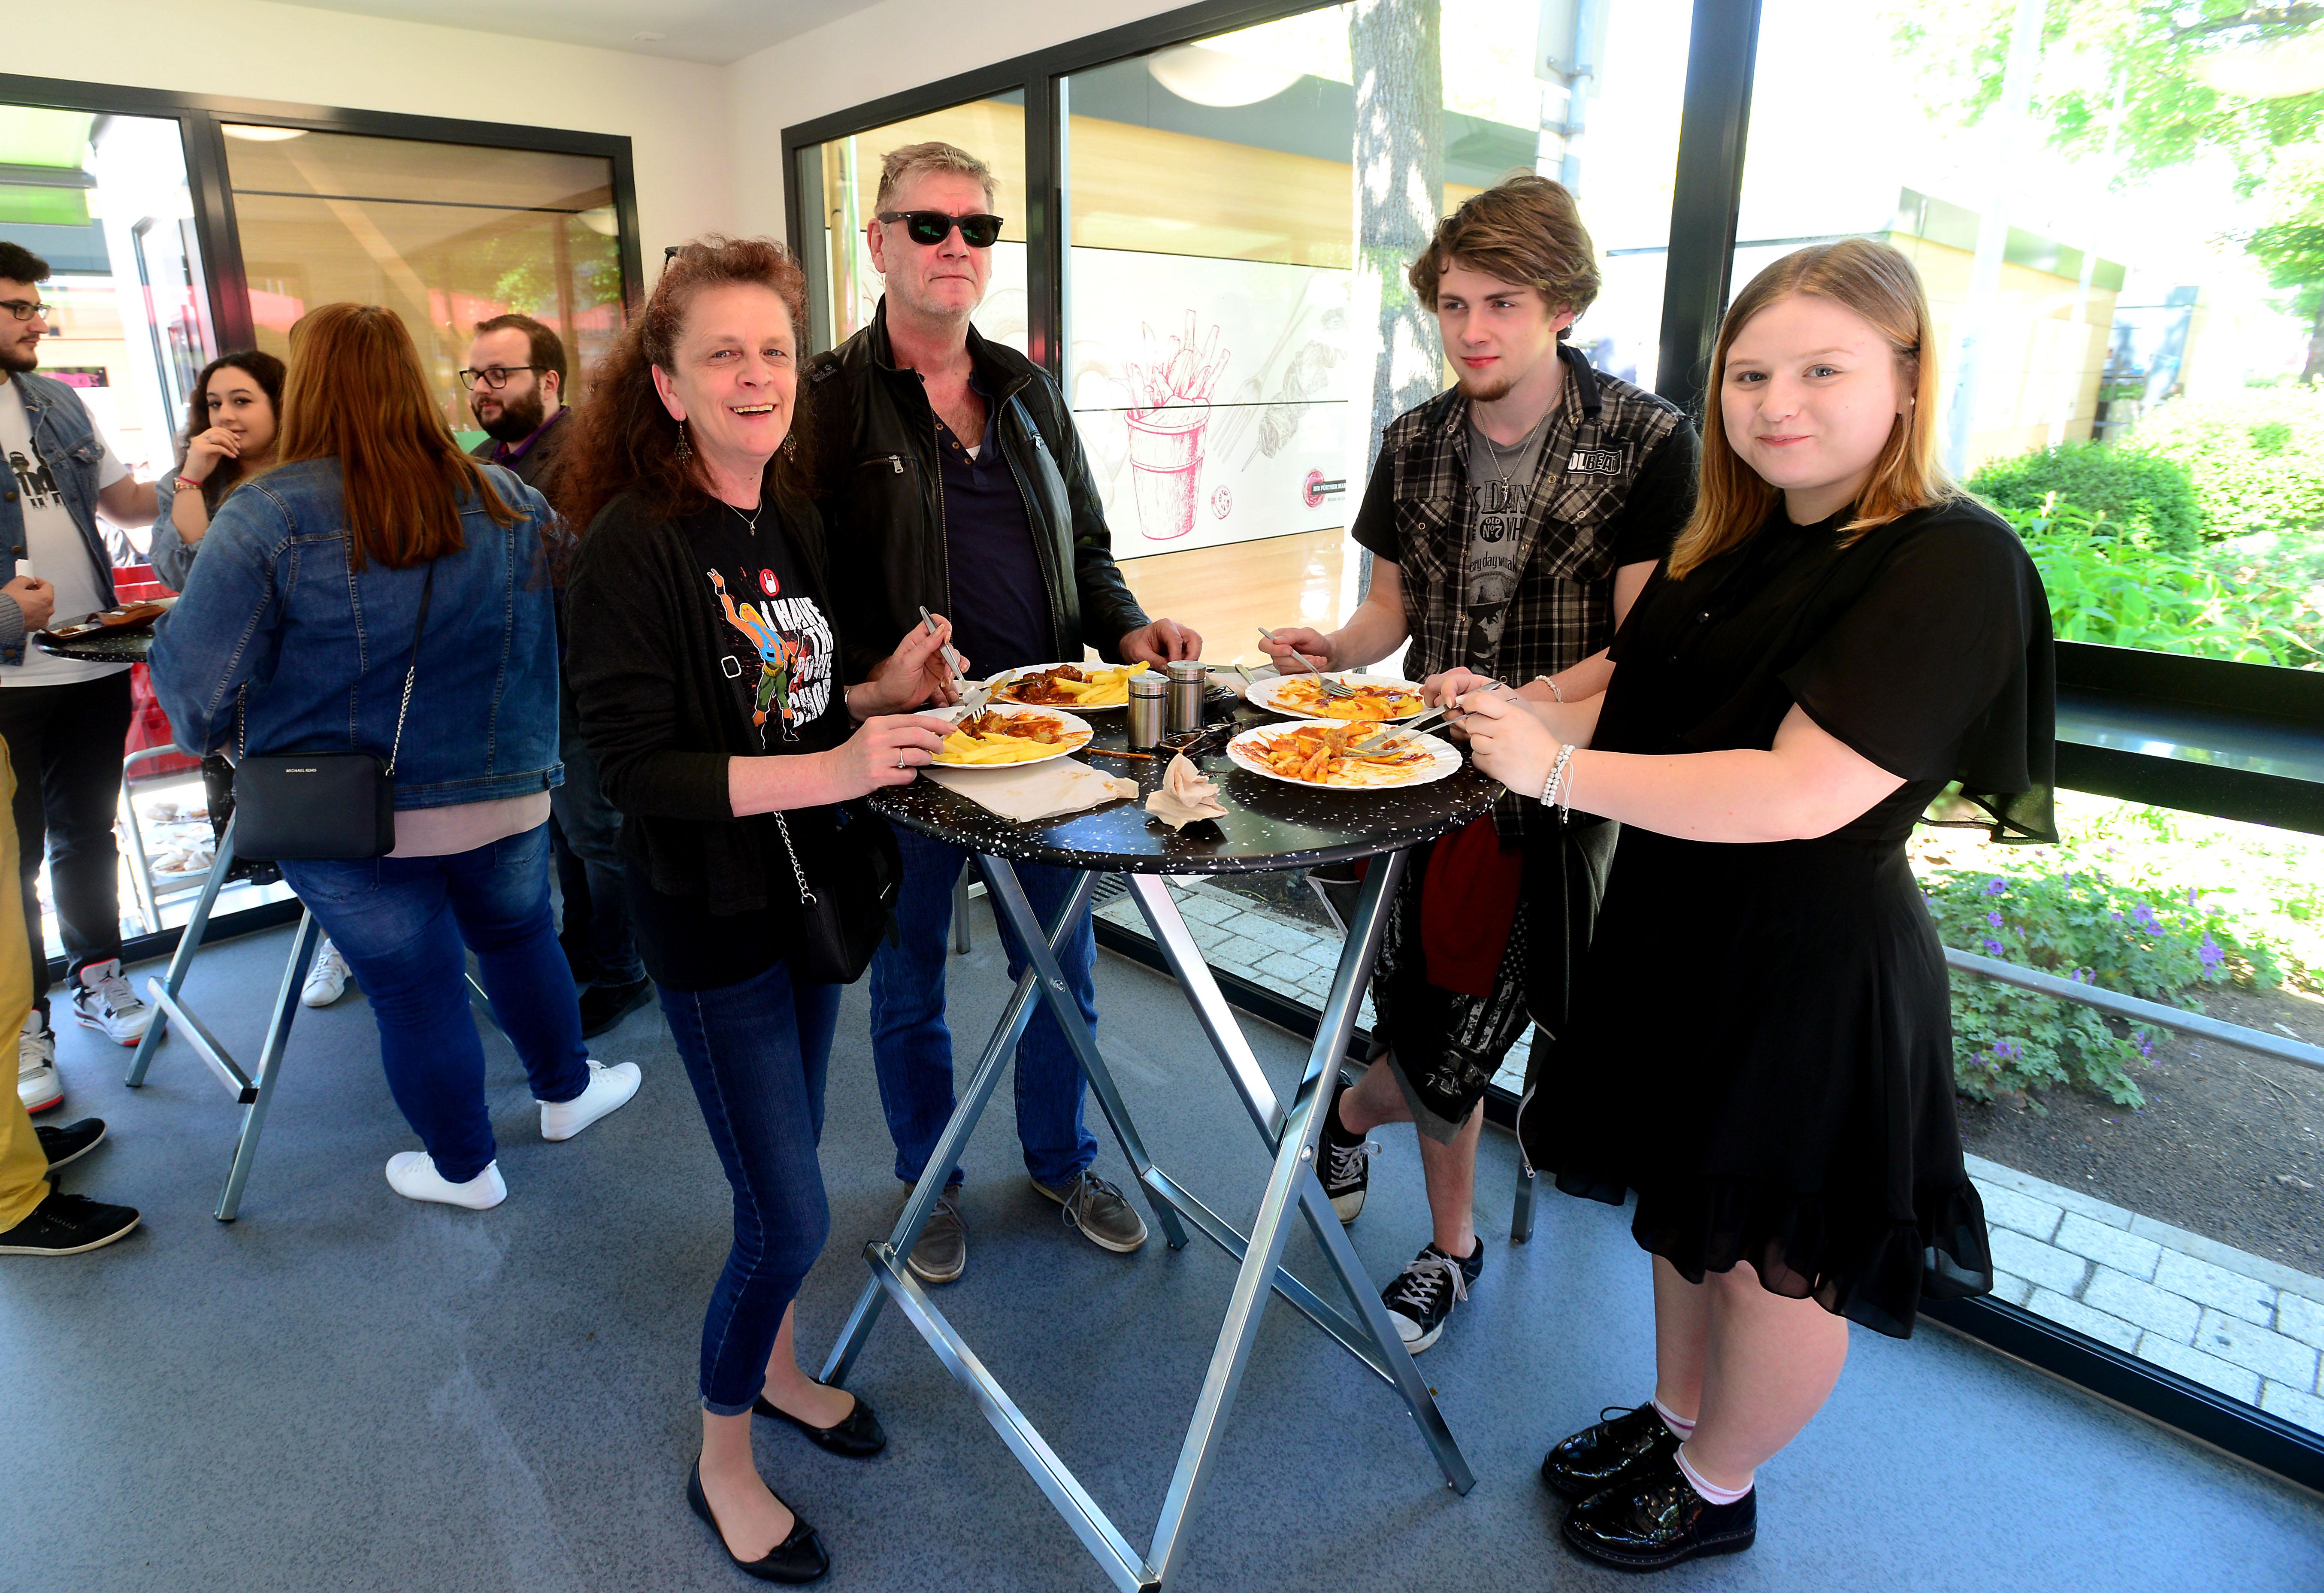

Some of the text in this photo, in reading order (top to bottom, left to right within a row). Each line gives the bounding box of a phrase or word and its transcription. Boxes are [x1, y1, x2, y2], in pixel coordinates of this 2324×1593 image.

[1483, 551, 1497, 569] day
[760, 597, 829, 632] I HAVE
